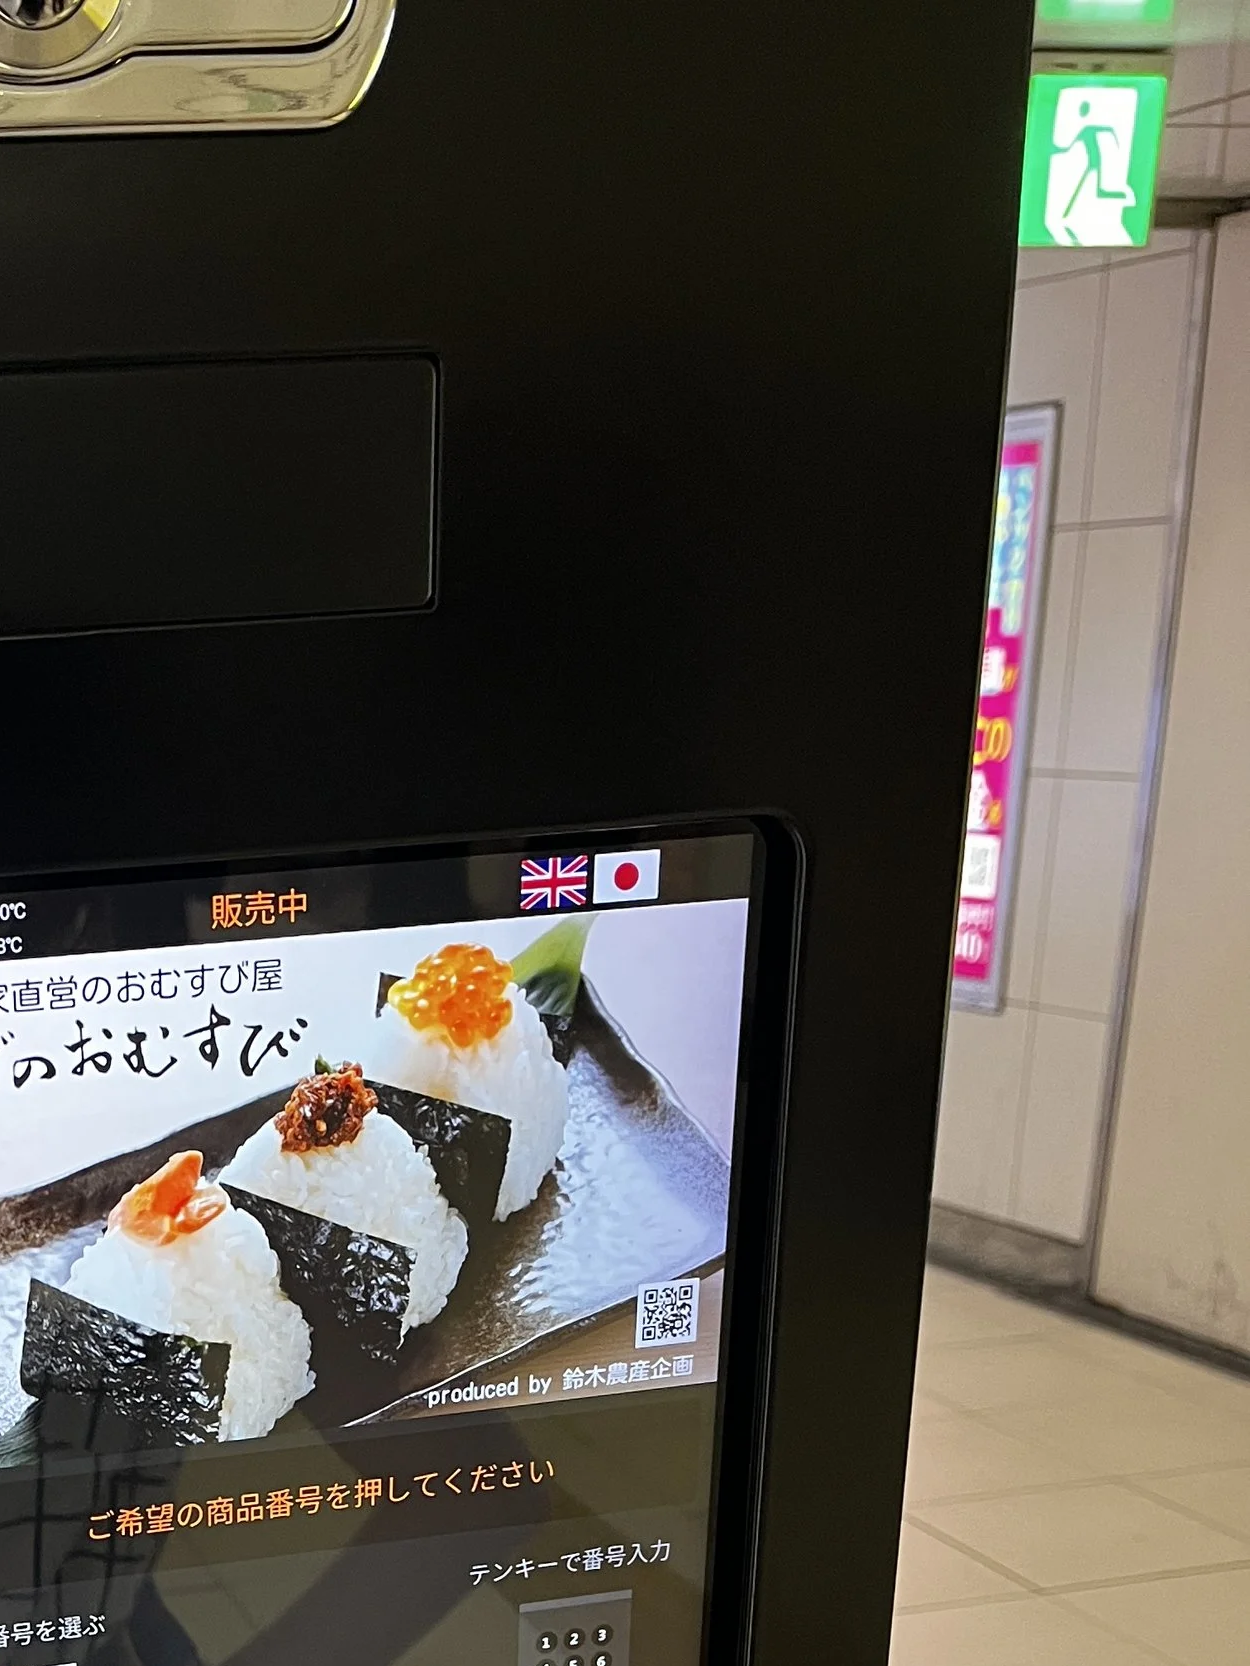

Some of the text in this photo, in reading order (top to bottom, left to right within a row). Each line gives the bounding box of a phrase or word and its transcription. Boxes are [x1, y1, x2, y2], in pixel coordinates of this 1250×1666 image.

[211, 887, 309, 930] 販売中
[427, 1353, 695, 1409] produced by 鈴木農産企画
[87, 1457, 556, 1542] ご希望の商品番号を押してください
[469, 1538, 672, 1586] テンキーで番号入力
[541, 1628, 607, 1650] 1 2 3
